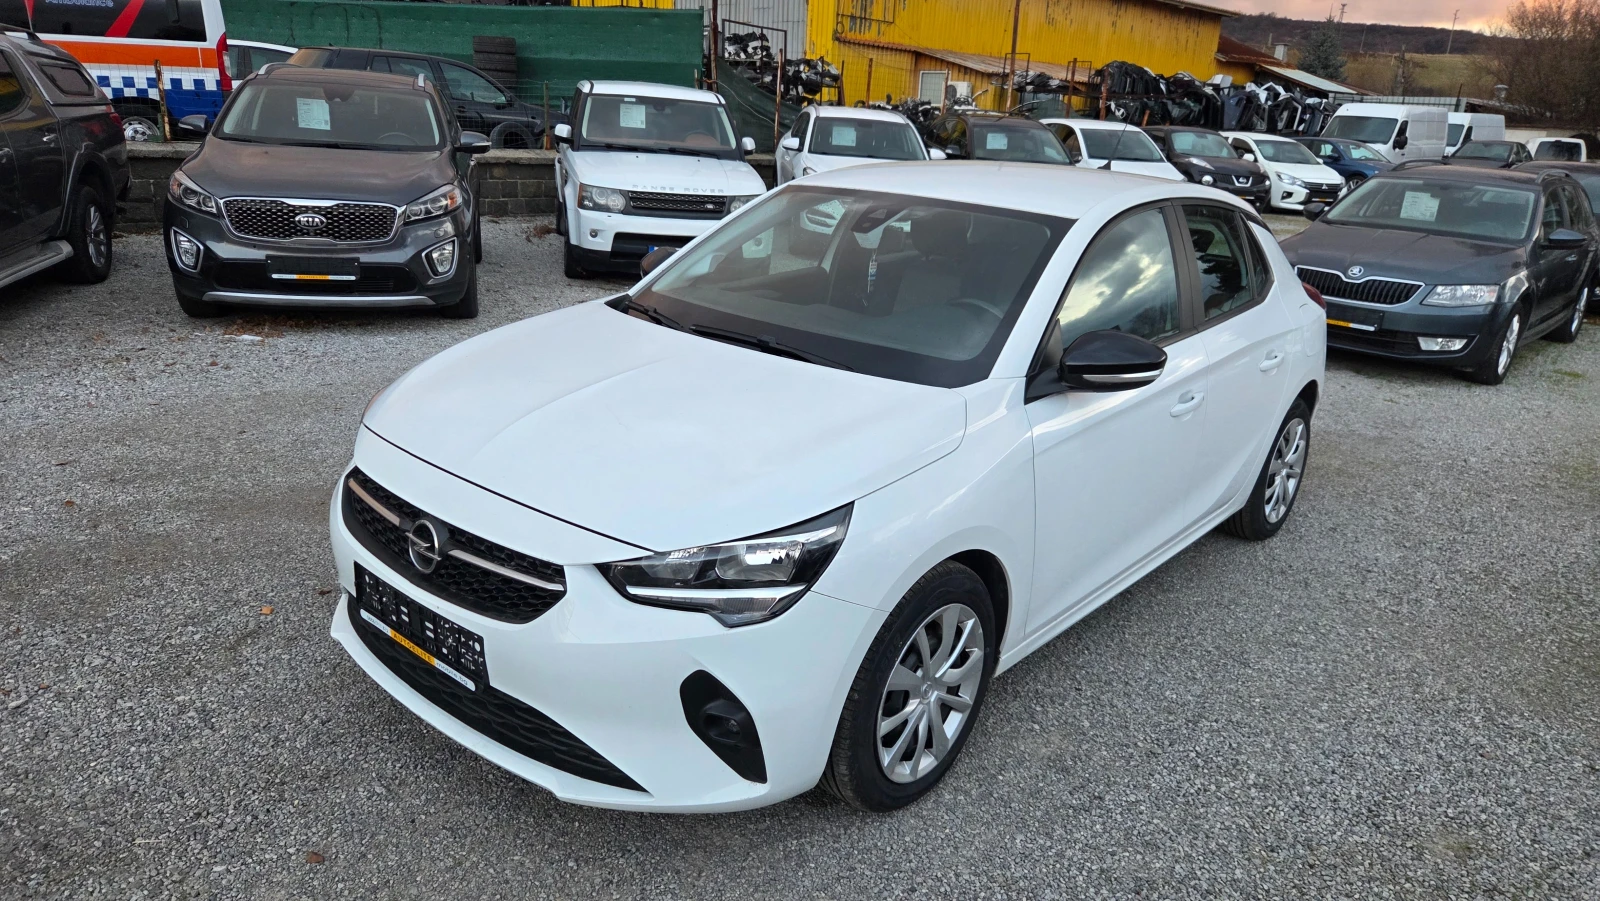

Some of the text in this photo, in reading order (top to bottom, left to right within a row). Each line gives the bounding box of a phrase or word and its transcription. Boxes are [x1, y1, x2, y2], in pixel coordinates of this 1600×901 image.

[632, 184, 675, 192] RANGE
[300, 217, 321, 227] KIA
[393, 633, 433, 662] AUTOELITE
